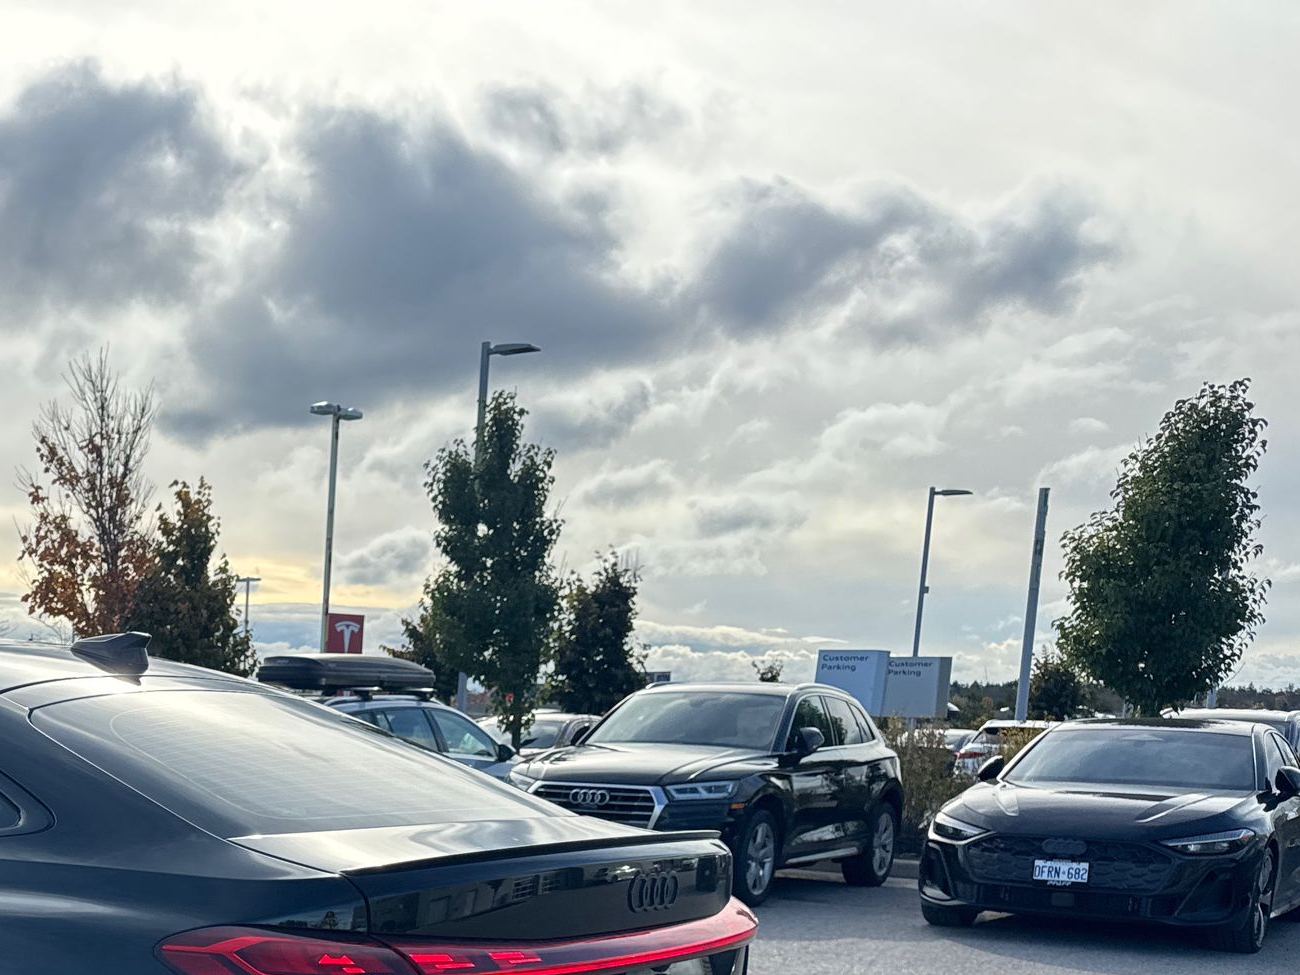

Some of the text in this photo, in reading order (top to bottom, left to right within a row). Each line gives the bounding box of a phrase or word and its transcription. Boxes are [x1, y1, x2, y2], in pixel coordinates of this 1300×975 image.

[822, 654, 869, 662] Customer
[821, 663, 857, 672] Parking
[888, 660, 933, 668] Customer
[888, 669, 922, 677] Parking
